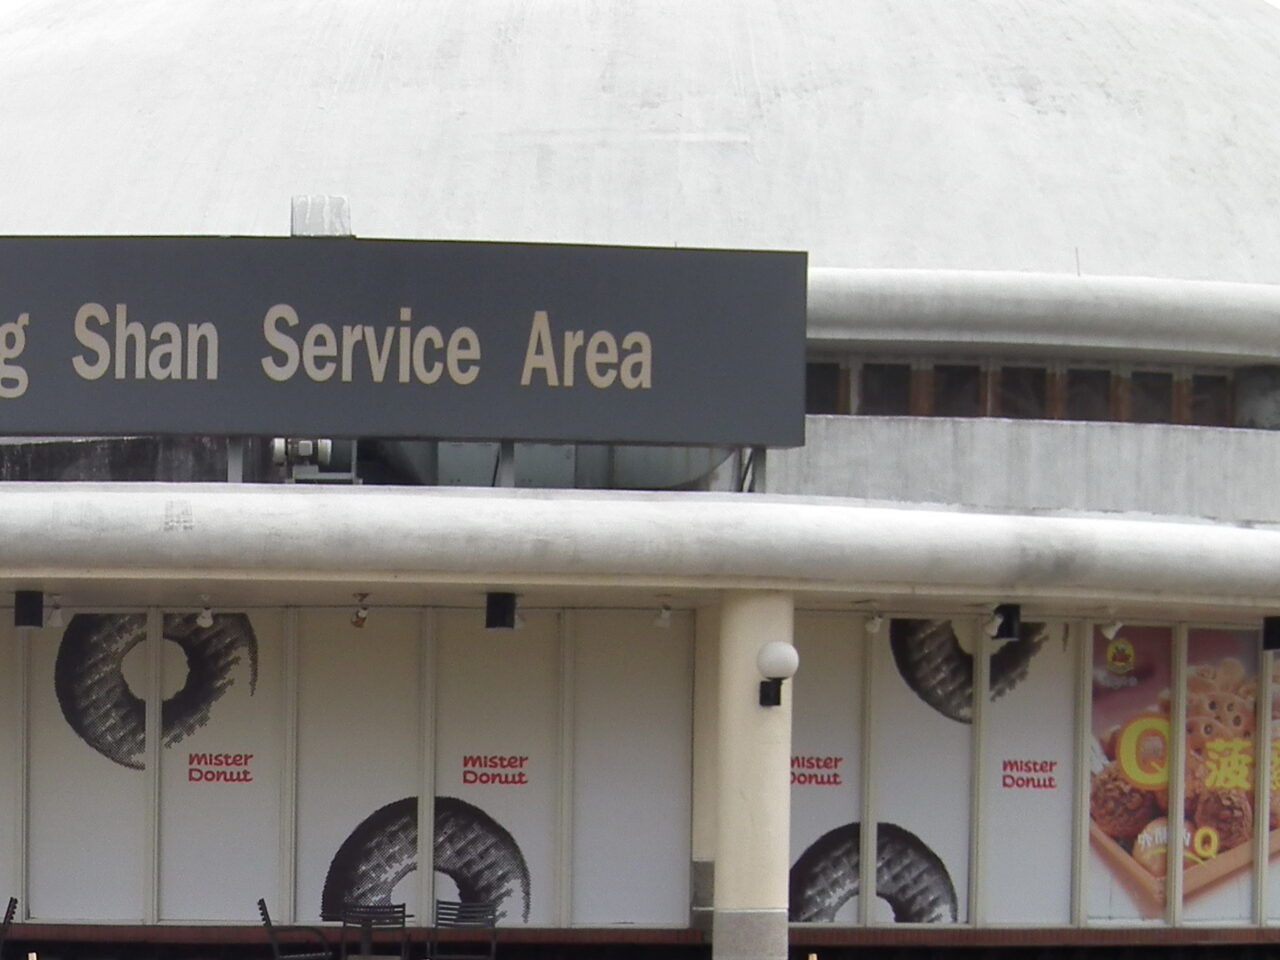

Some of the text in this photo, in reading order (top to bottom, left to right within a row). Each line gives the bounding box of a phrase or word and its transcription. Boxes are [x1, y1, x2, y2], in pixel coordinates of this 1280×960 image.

[71, 302, 219, 381] Shan
[261, 303, 481, 385] Service
[521, 310, 652, 389] Area
[188, 769, 253, 782] Donut
[463, 771, 528, 784] Donut
[1002, 774, 1057, 789] Donut
